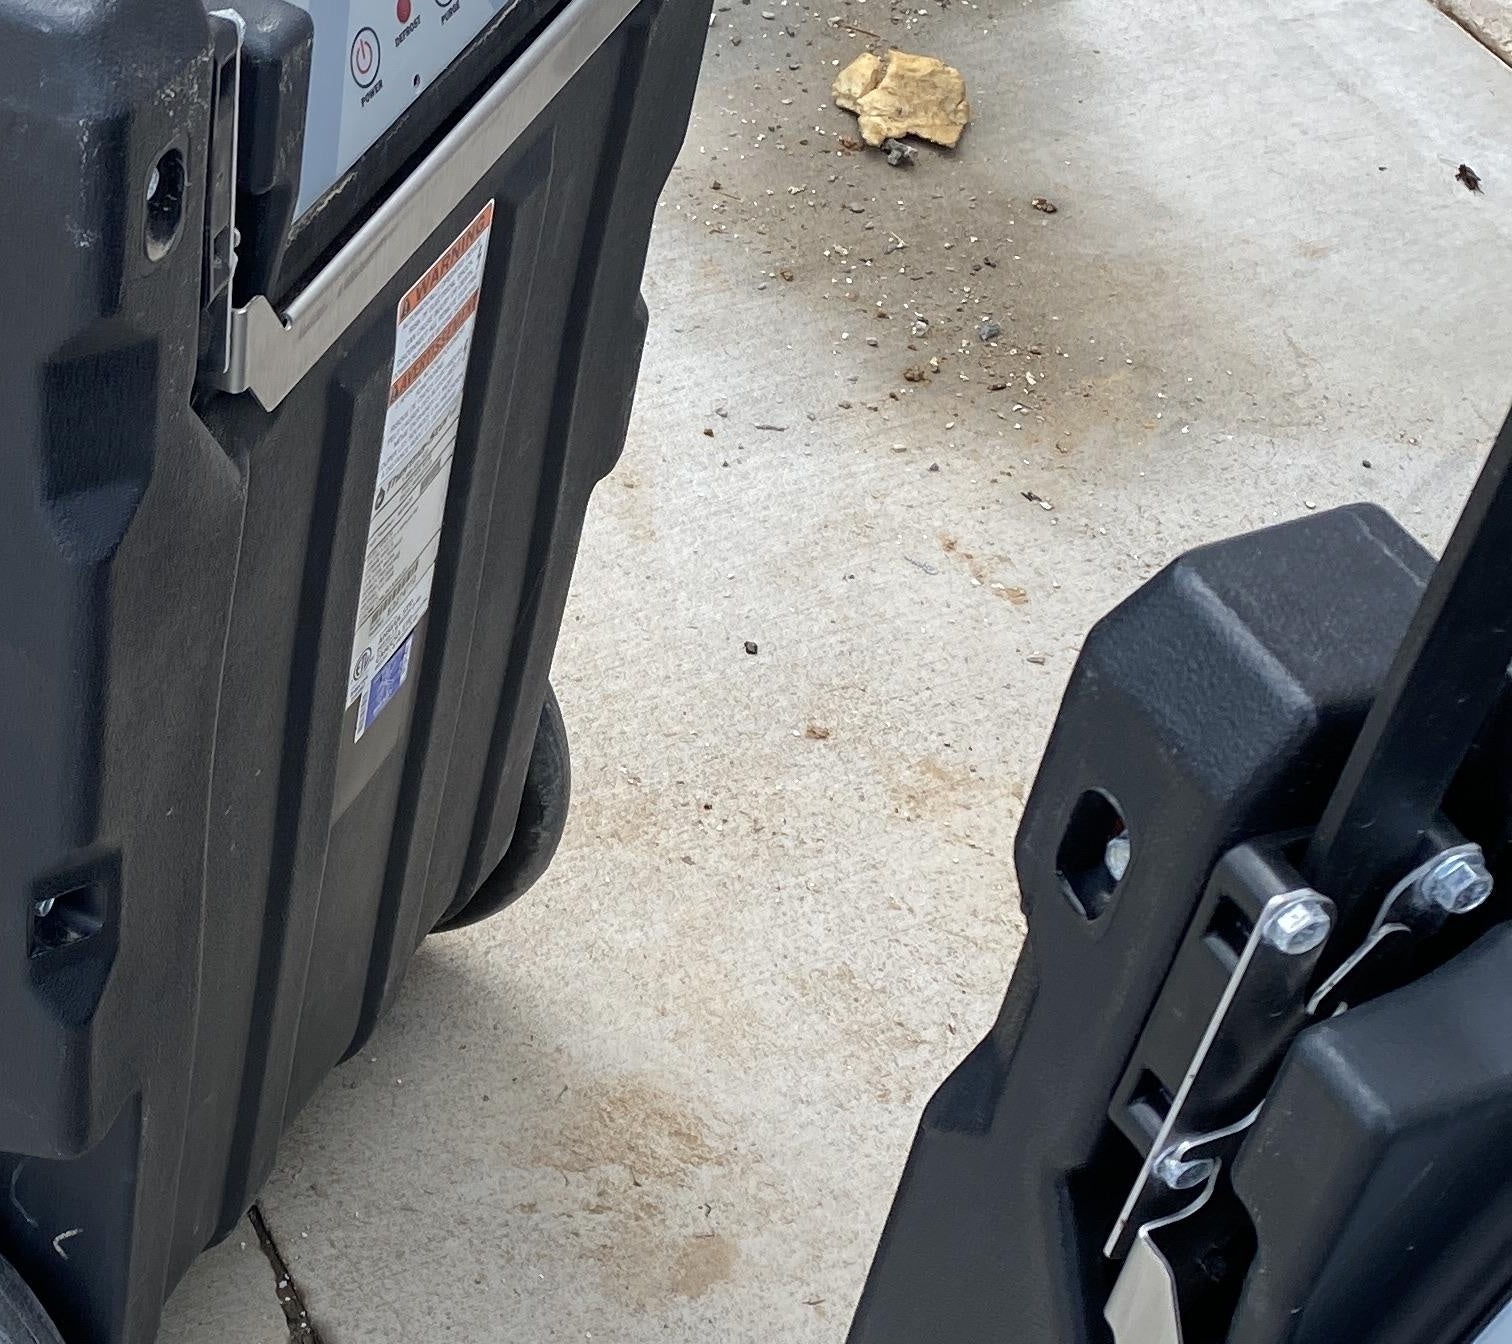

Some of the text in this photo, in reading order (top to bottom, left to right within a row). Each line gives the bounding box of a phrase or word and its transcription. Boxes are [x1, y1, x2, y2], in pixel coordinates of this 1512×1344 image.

[440, 0, 460, 26] PURGE
[393, 14, 422, 48] DEFROST
[360, 77, 384, 108] POWER
[416, 213, 487, 304] WARNING
